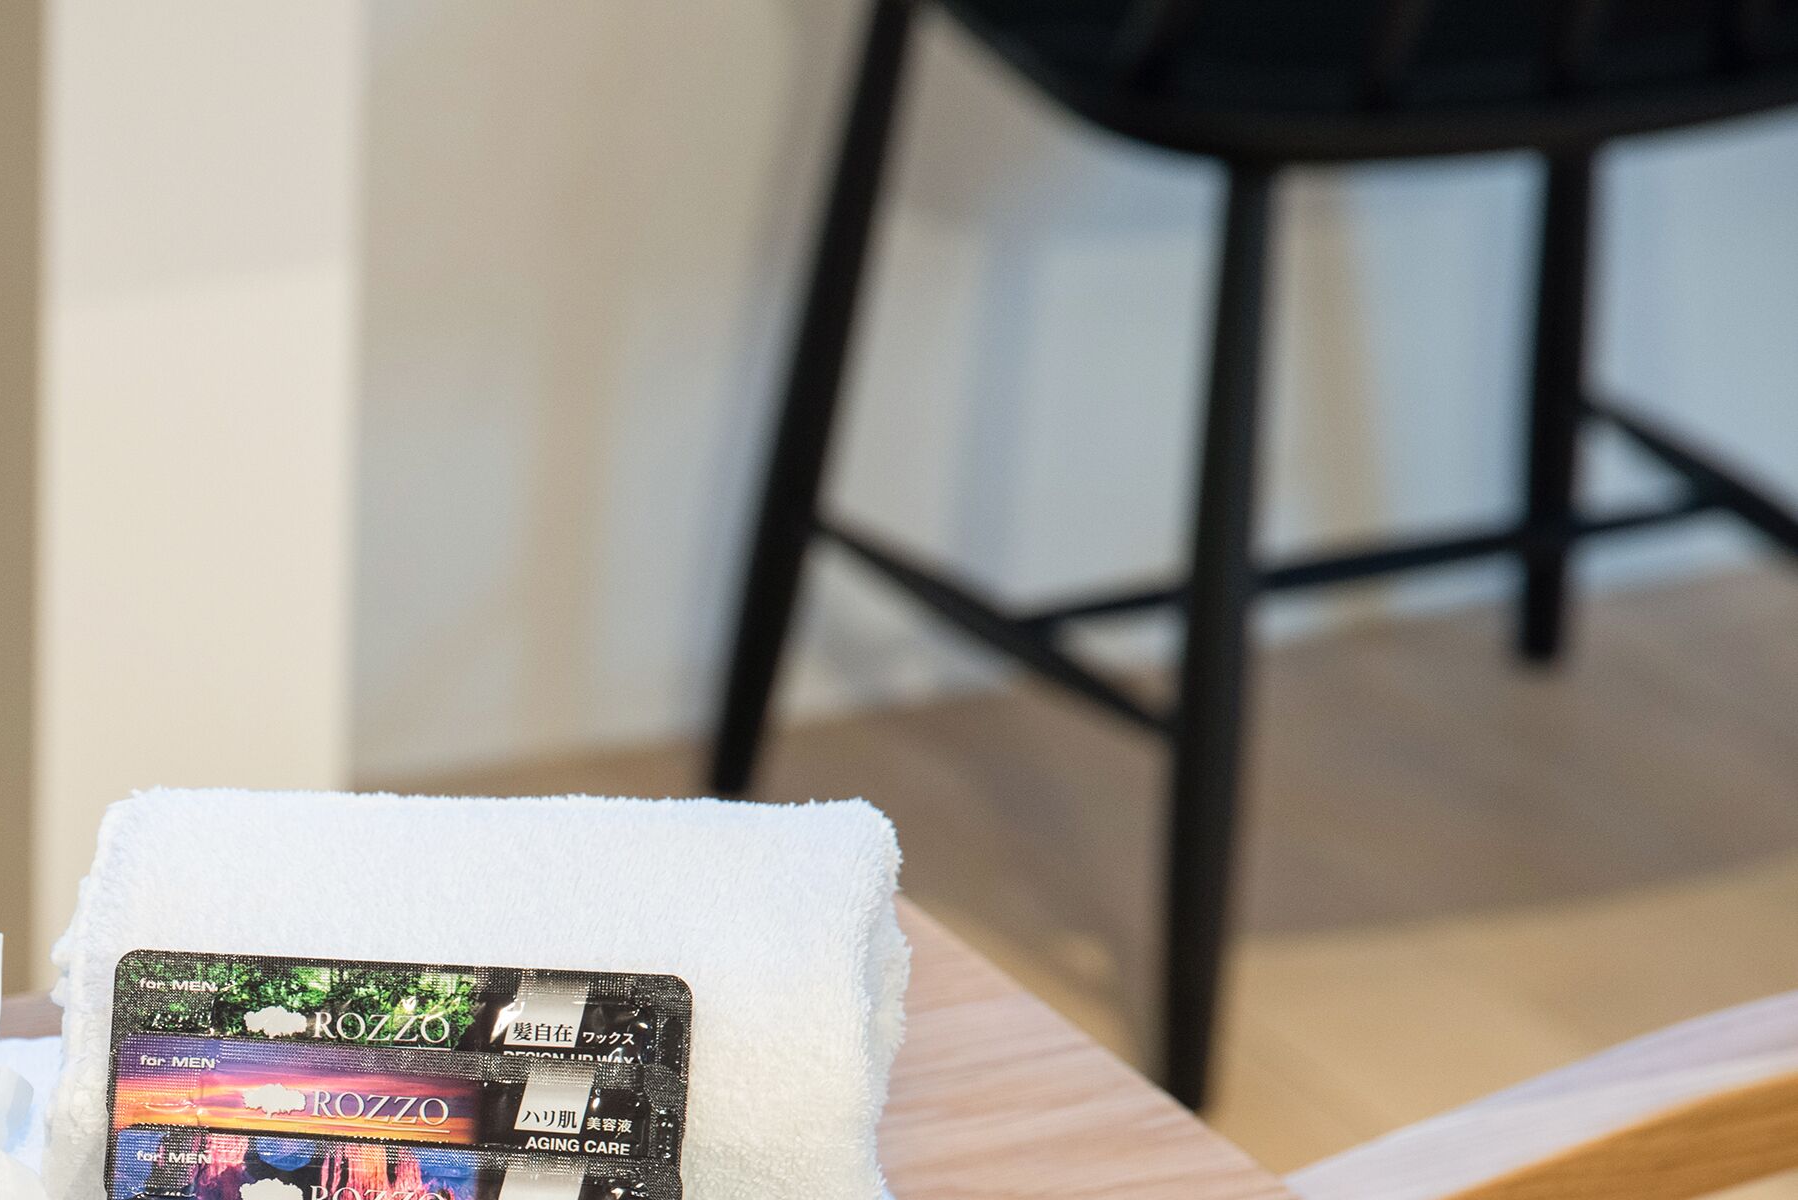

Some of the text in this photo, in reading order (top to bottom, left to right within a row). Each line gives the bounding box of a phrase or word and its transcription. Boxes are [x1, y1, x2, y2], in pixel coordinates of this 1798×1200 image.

[139, 978, 216, 992] for MEN
[313, 1010, 451, 1045] ROZZO
[513, 1022, 573, 1043] 髪自在
[582, 1031, 635, 1046] ワックス
[139, 1054, 216, 1070] for MEN
[311, 1089, 450, 1126] ROZZO
[521, 1110, 577, 1129] ハリ肌
[586, 1116, 633, 1134] 美容液
[525, 1136, 631, 1156] AGING CARE
[136, 1150, 213, 1165] for MEN
